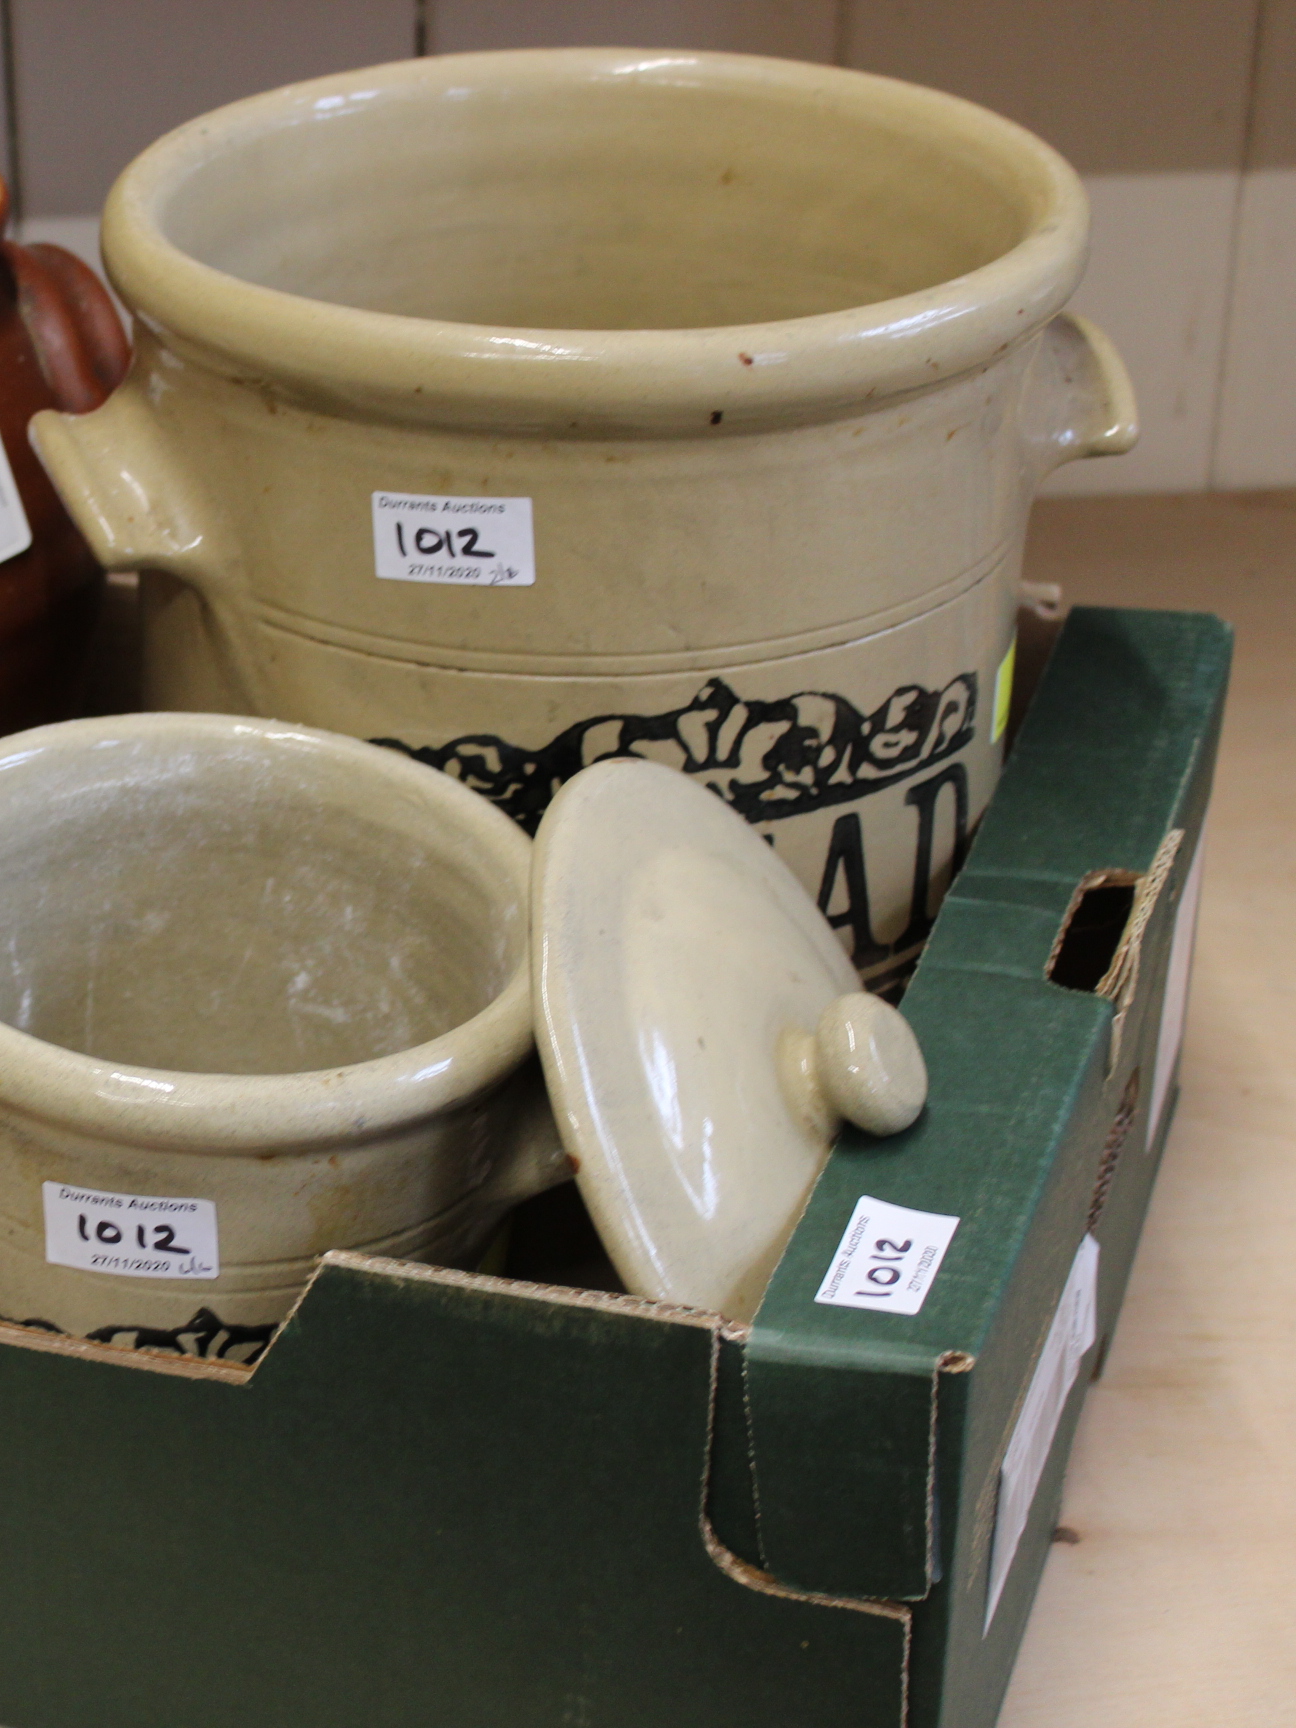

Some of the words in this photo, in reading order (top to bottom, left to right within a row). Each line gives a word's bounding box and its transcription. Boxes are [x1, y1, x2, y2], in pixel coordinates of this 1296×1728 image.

[378, 495, 437, 512] Durrants
[441, 499, 506, 514] Auctions
[396, 521, 495, 558] 1012
[407, 563, 482, 578] 27/11/2020
[58, 1187, 124, 1209] Durrants
[127, 1198, 198, 1213] Auctions
[78, 1213, 192, 1255] 1012
[91, 1253, 171, 1272] 27/11/2020
[821, 1259, 851, 1299] Durrants
[841, 1214, 870, 1258] Auctions
[854, 1238, 913, 1297] 1012
